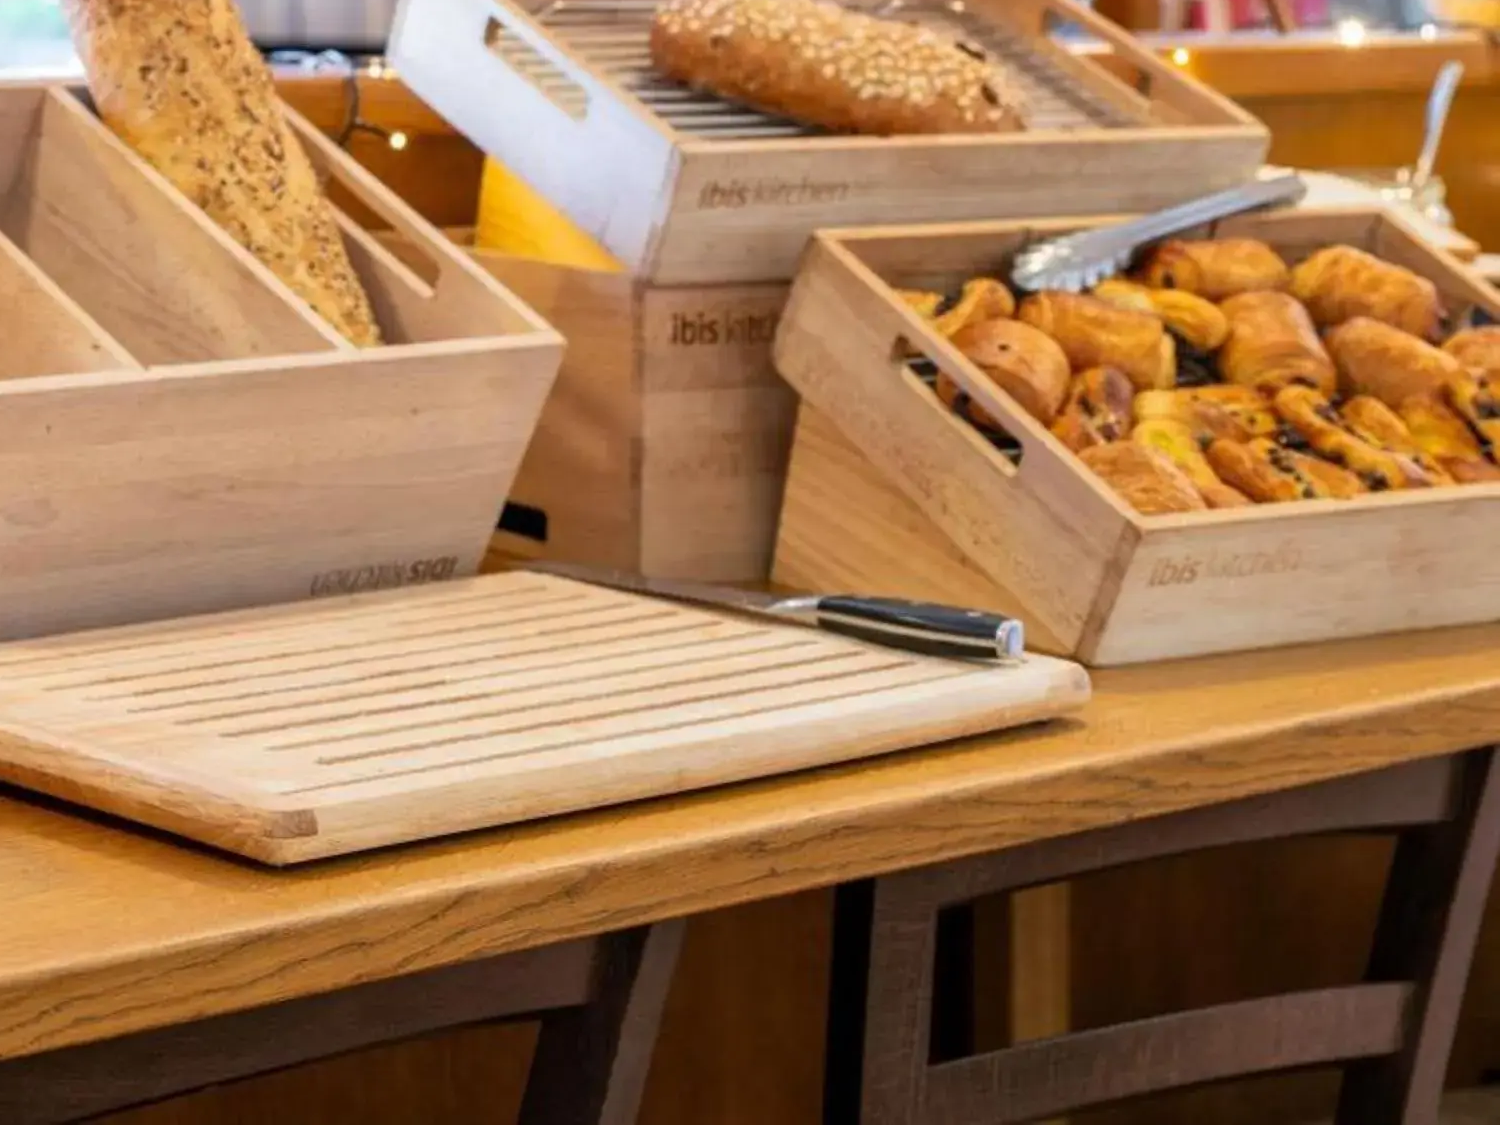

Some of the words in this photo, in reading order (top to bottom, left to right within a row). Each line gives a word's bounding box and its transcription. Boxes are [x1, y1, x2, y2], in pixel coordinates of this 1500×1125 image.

[697, 180, 749, 209] ibis
[753, 176, 850, 205] kitchen
[670, 312, 718, 345] ibis
[1147, 555, 1202, 587] ibis
